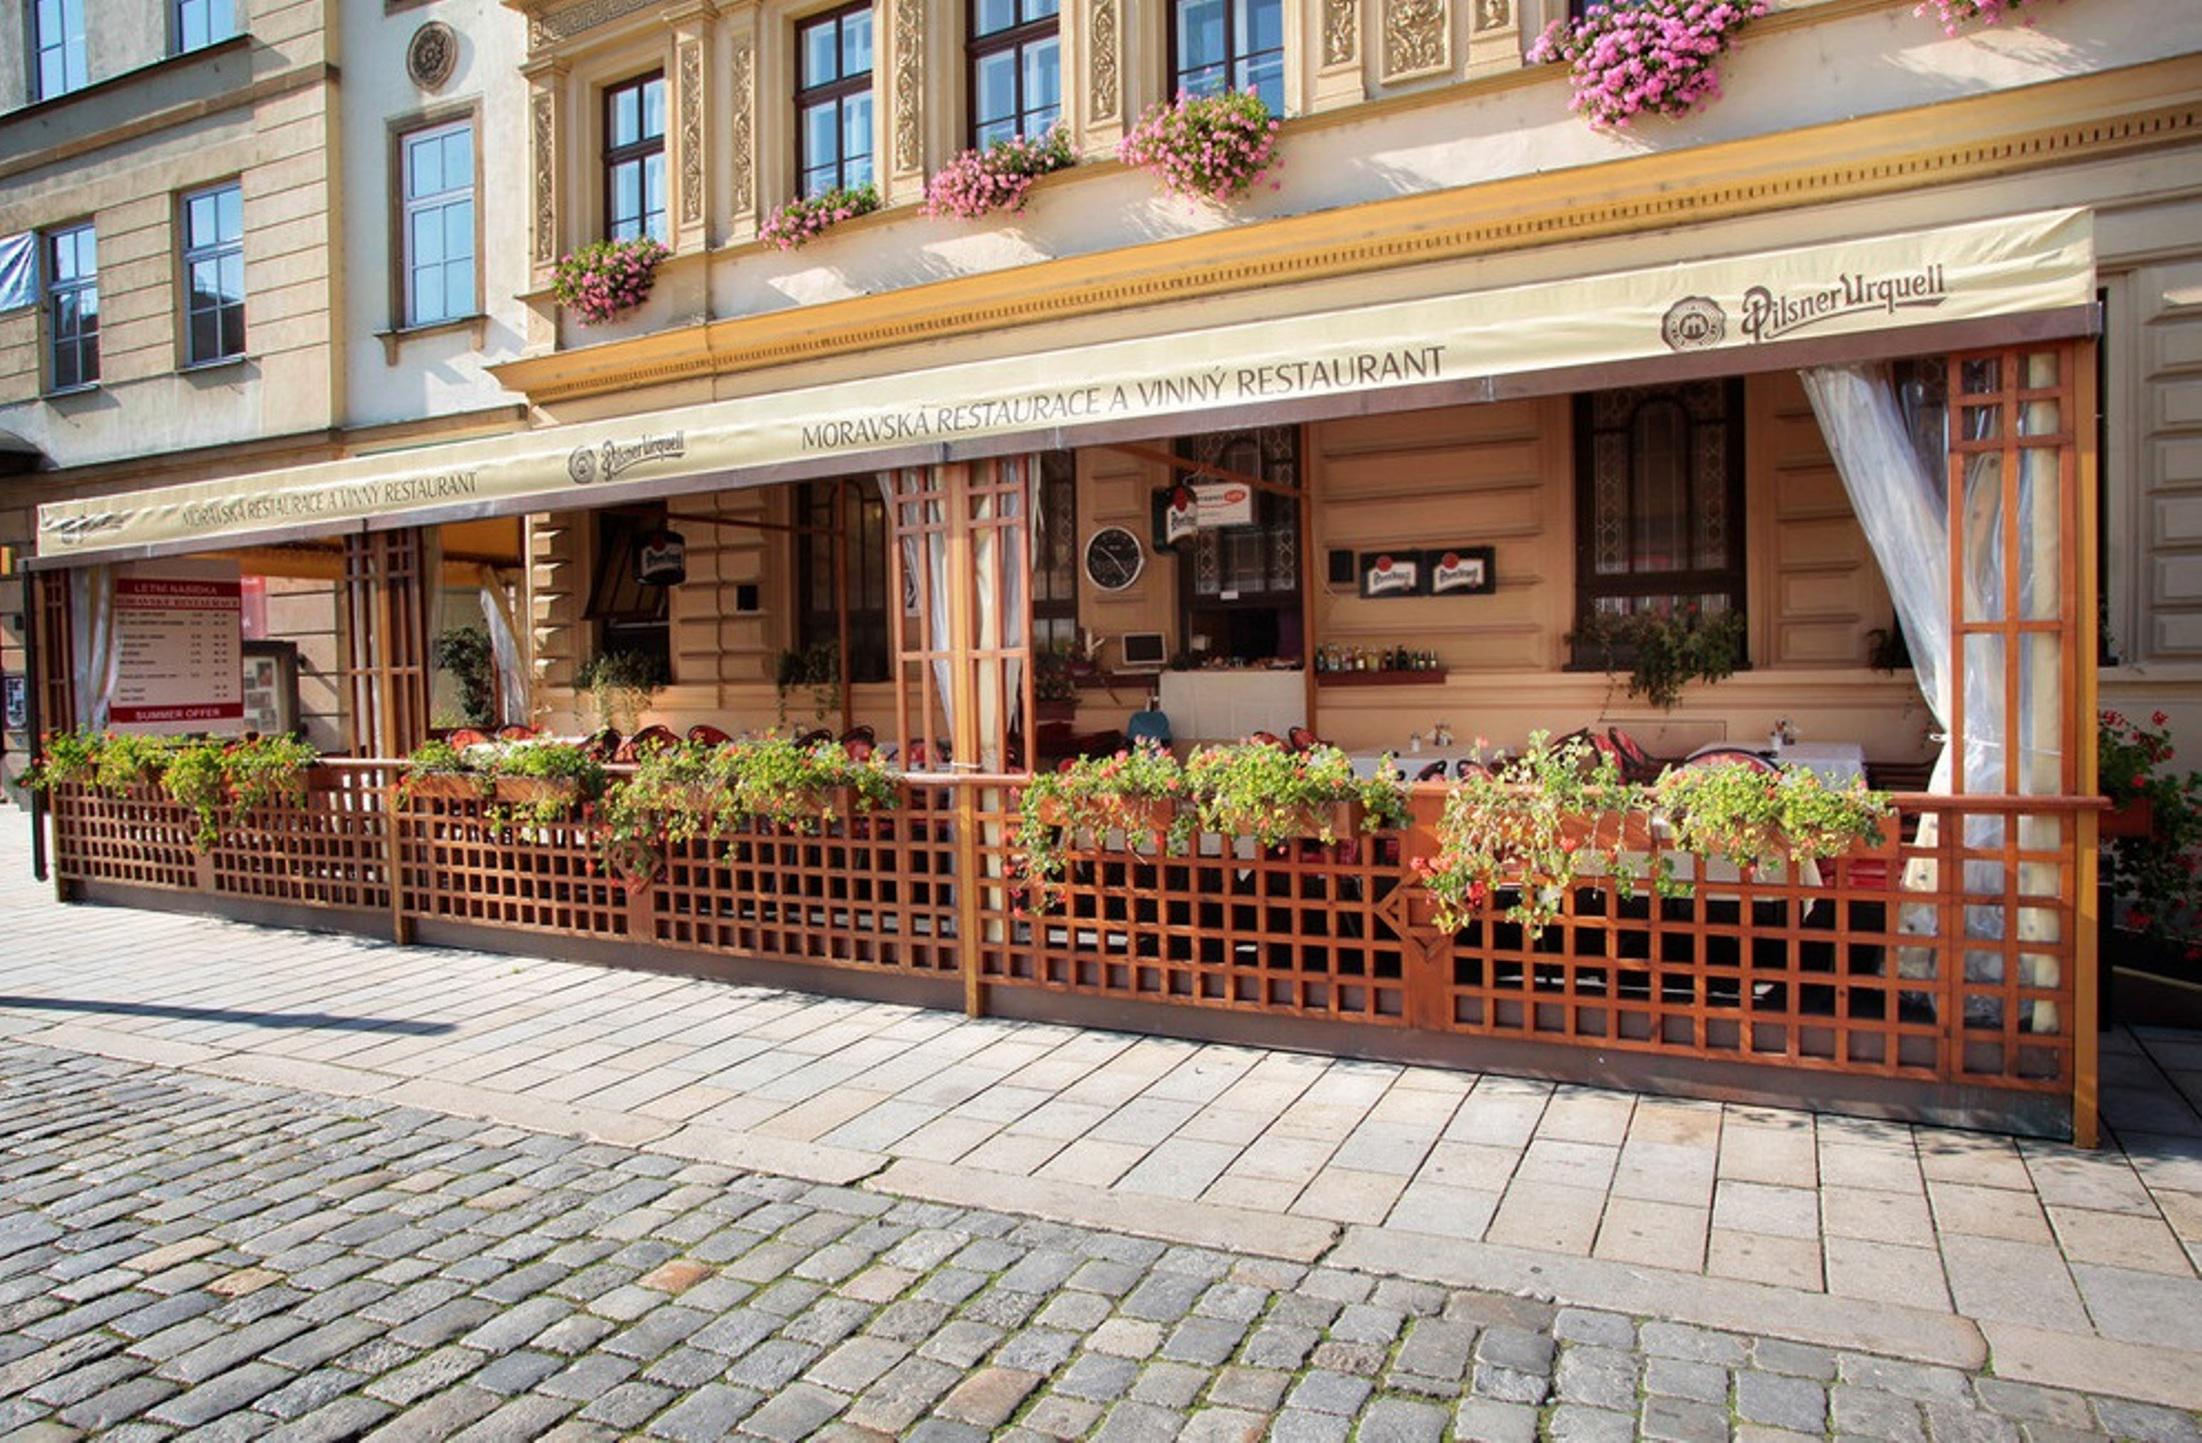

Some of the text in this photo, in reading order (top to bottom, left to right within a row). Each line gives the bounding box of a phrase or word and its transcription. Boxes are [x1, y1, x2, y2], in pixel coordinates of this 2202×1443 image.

[1741, 263, 1945, 343] Pilsner Urquell
[801, 345, 1446, 451] MORAVSKÁ RESTAURACE A VINNÝ RESTAURANT
[384, 471, 477, 502] RESTAURANT
[135, 707, 220, 720] SUMMER OFFER
